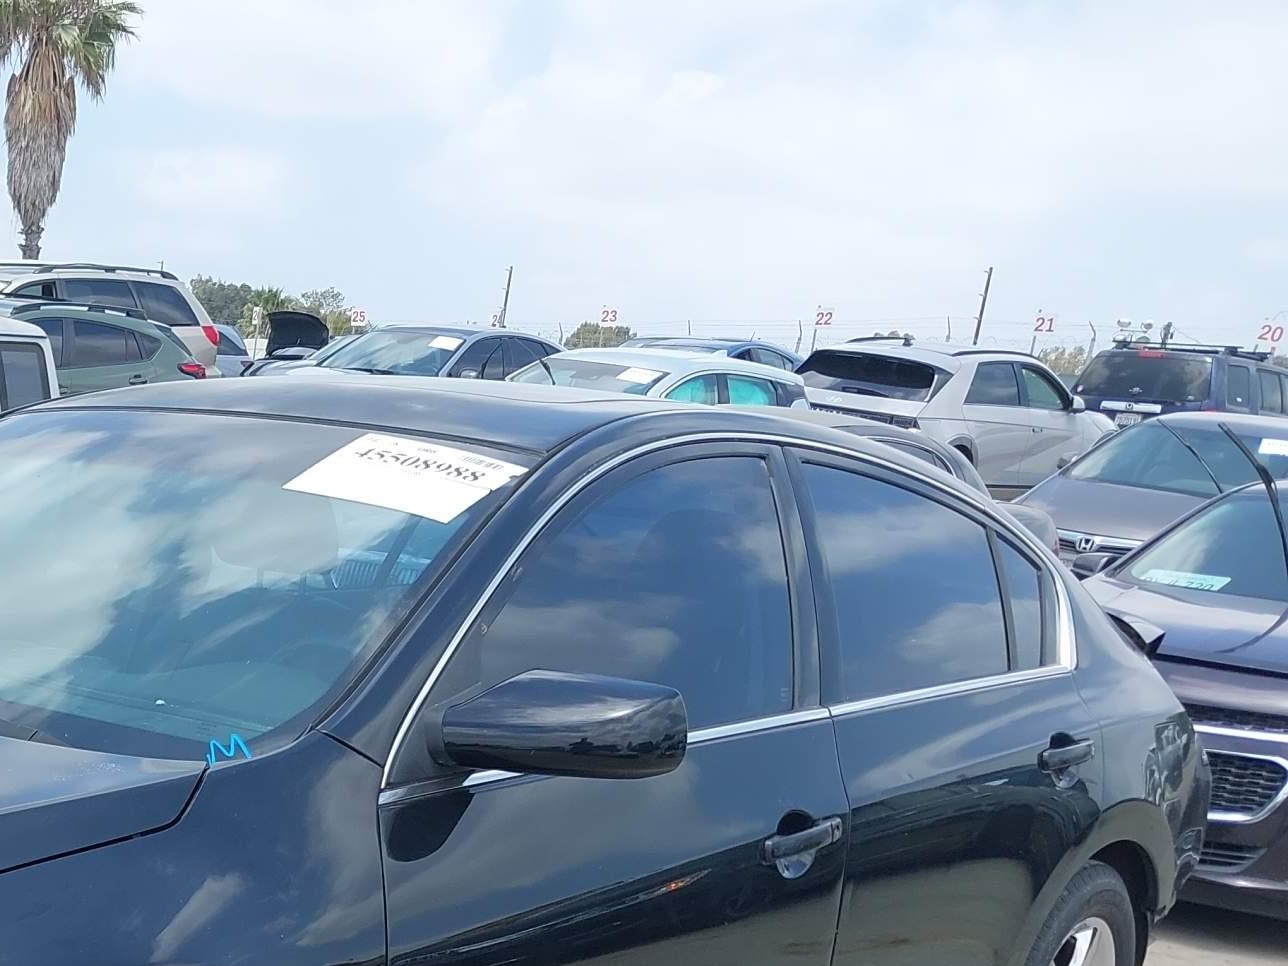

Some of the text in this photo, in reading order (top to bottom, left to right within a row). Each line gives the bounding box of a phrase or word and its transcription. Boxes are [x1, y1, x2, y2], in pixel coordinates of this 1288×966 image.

[352, 311, 366, 323] 25
[600, 310, 618, 323] 23
[815, 311, 833, 326] 22
[1033, 316, 1055, 332] 21
[1256, 324, 1284, 342] 20
[355, 447, 486, 482] 45508988
